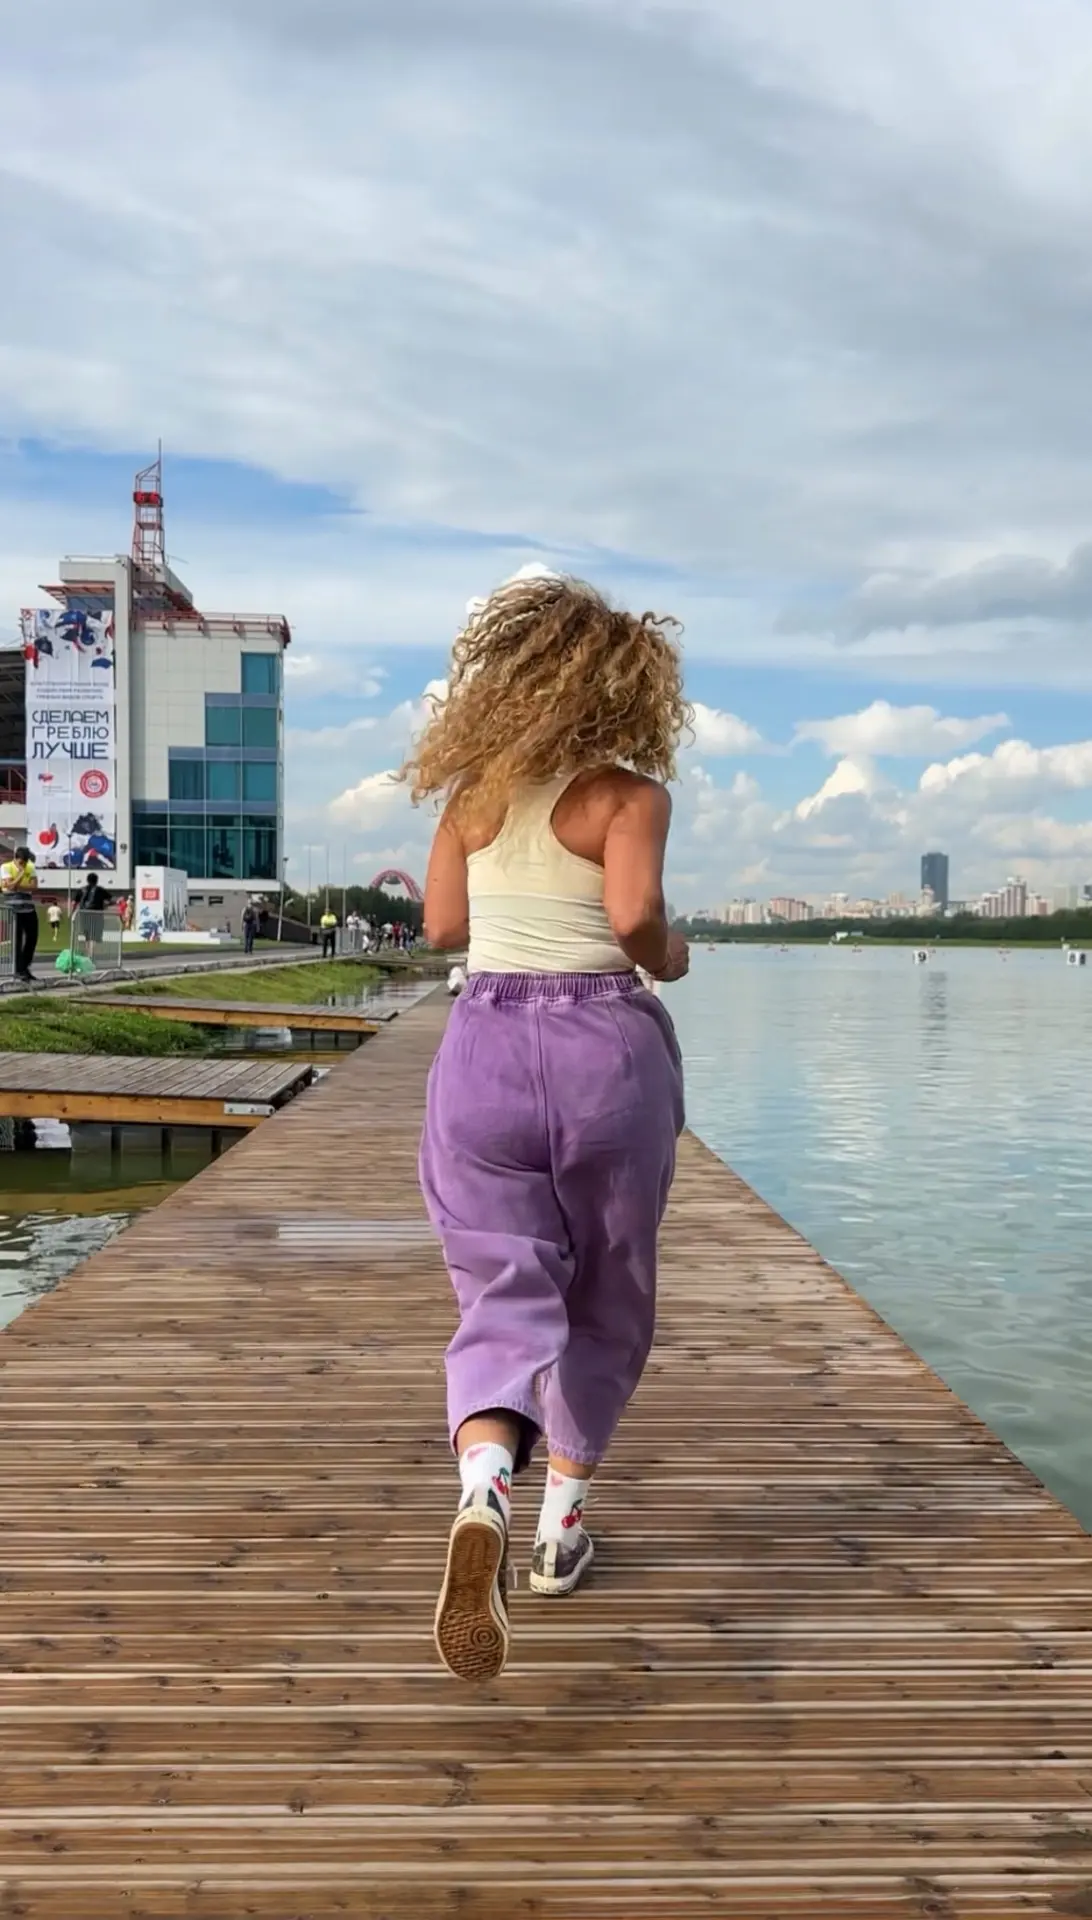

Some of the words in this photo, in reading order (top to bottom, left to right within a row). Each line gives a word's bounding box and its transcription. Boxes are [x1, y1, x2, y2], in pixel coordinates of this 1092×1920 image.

[32, 710, 109, 725] СДЕЛАЕМ
[32, 726, 109, 740] ГРЕБЛЮ
[32, 742, 109, 760] ЛУЧШЕ
[918, 951, 926, 962] 9
